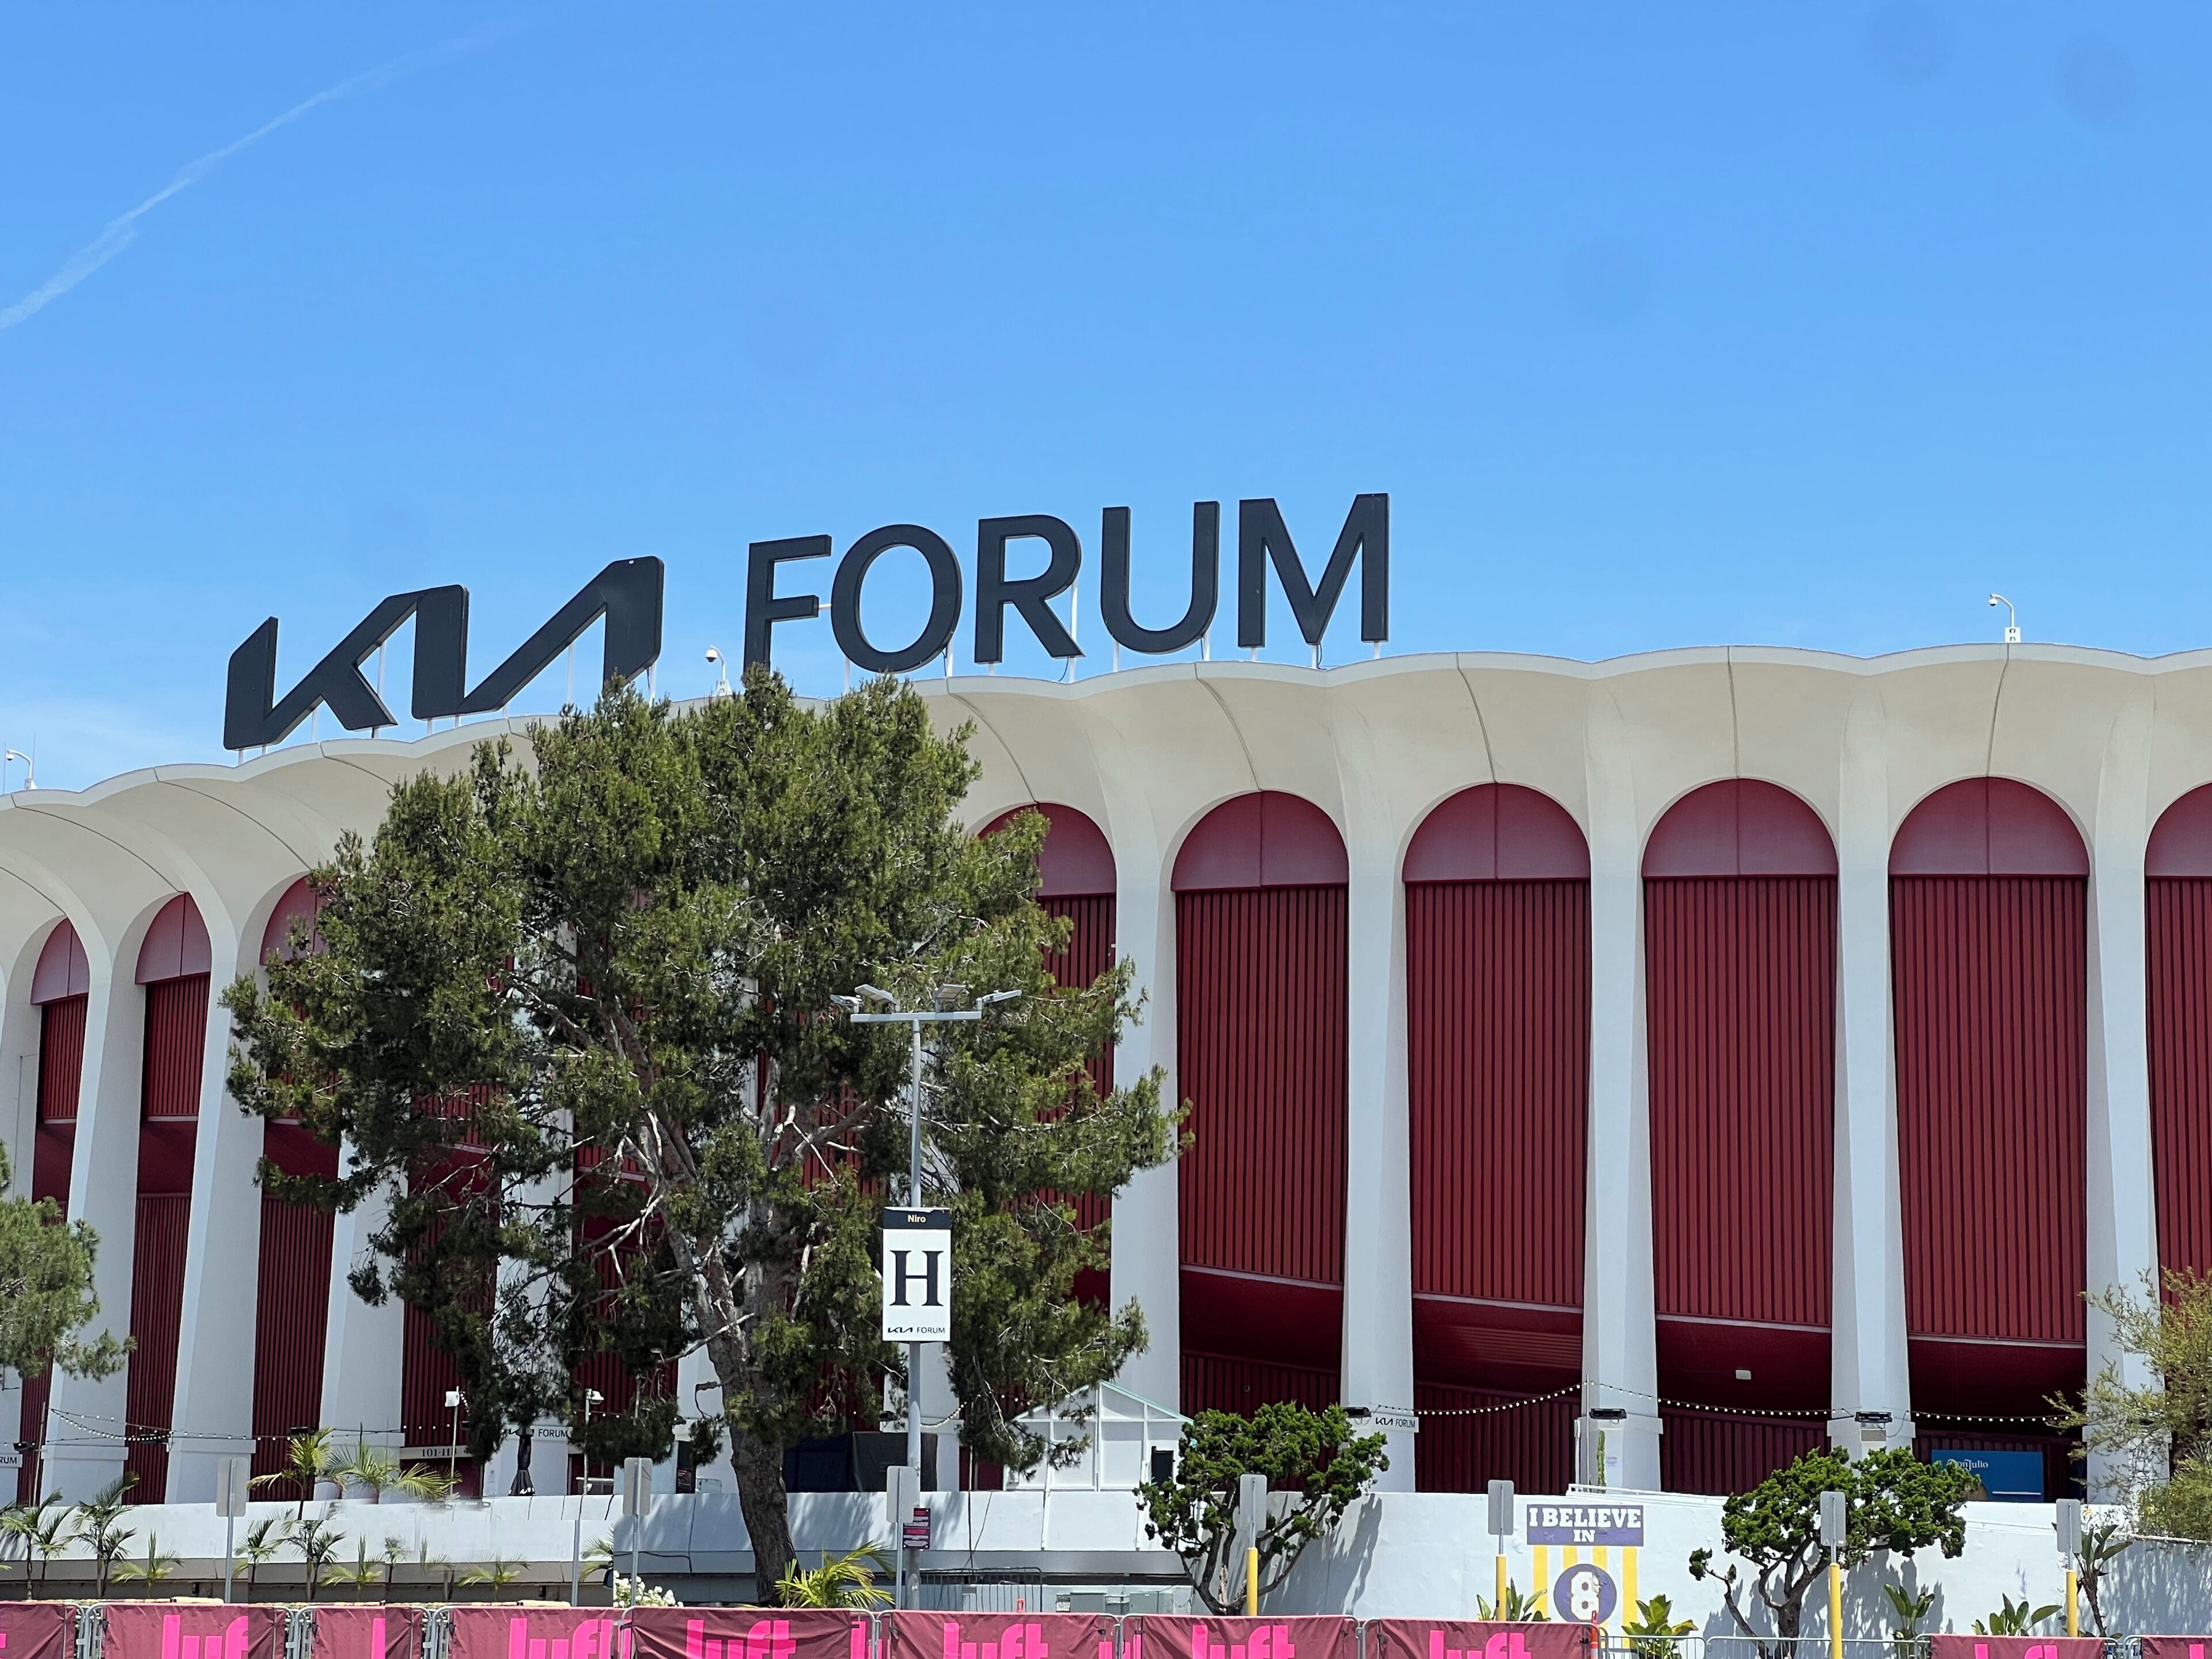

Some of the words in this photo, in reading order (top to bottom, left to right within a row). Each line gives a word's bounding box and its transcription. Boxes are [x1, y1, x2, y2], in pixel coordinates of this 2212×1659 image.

[224, 556, 665, 750] KIA
[743, 494, 1389, 674] FORUM
[907, 1214, 926, 1223] Niro
[889, 1250, 944, 1306] H
[1395, 1418, 1415, 1428] FORUM
[538, 1429, 568, 1438] FORUM
[1529, 1508, 1539, 1527] I
[1542, 1508, 1641, 1528] BELIEVE
[1573, 1529, 1596, 1543] IN
[1570, 1571, 1600, 1621] 8
